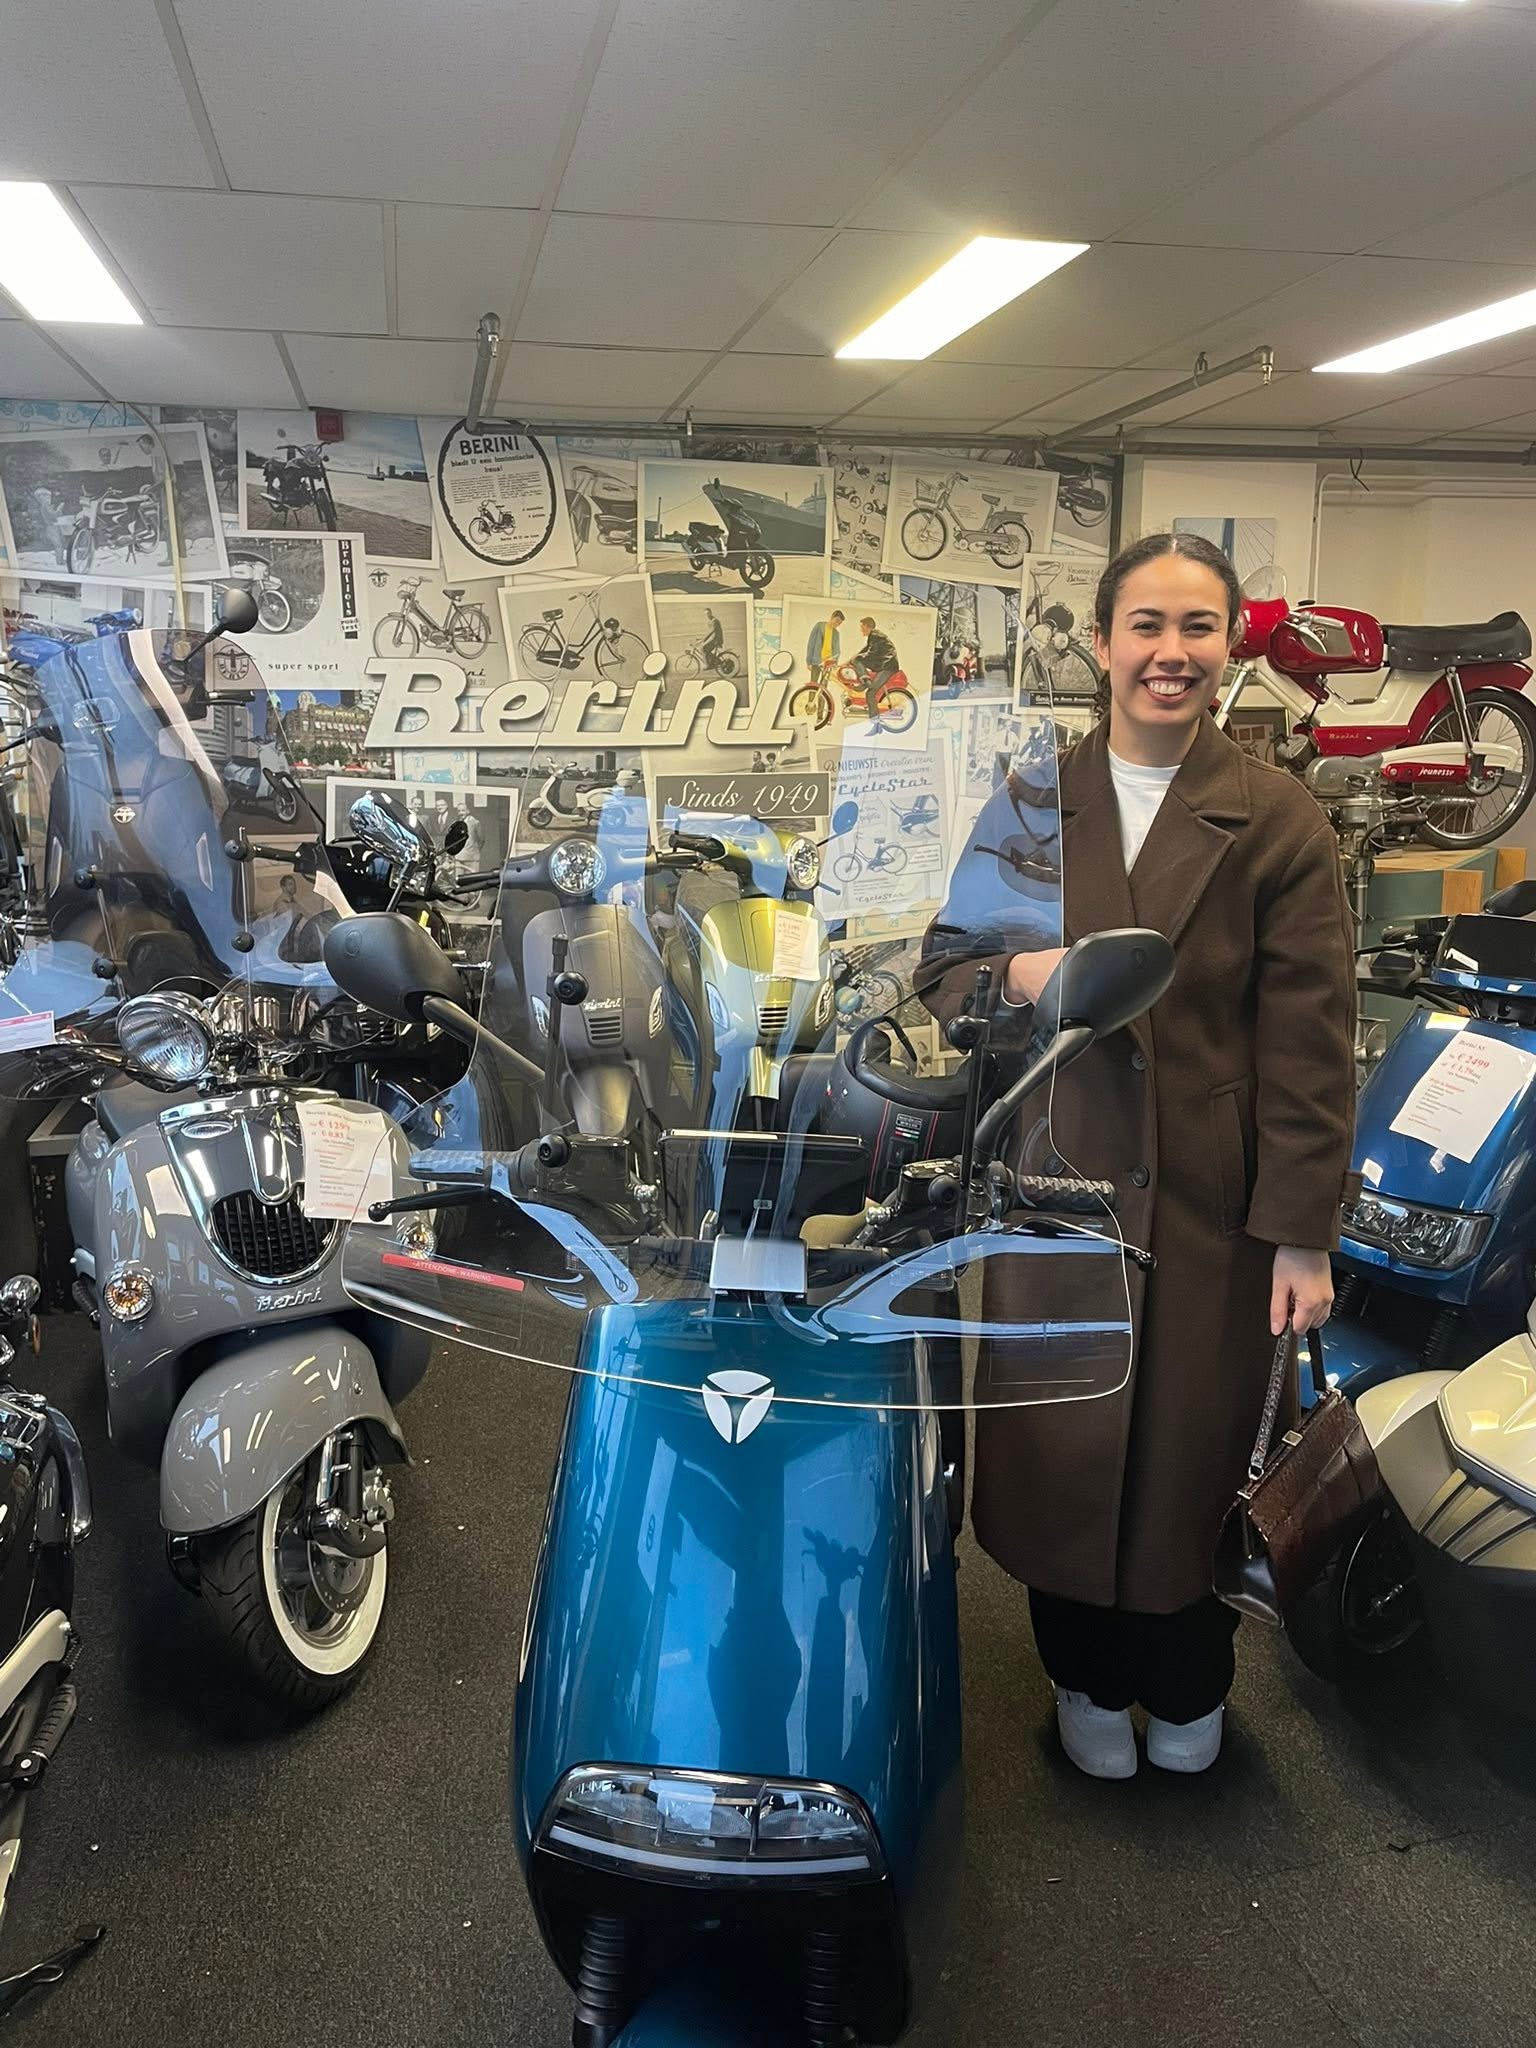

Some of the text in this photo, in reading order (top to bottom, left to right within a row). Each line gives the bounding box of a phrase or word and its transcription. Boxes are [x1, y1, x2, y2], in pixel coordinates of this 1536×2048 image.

[460, 435, 519, 456] BERINI
[268, 662, 339, 671] super sport
[364, 650, 797, 748] Berini
[838, 757, 879, 772] NIEUWSTE
[1417, 766, 1455, 777] jeunesse
[668, 780, 819, 814] Sinds 1949
[838, 776, 933, 798] CycleStar
[1466, 1055, 1490, 1069] 2499
[257, 1287, 322, 1311] Berini
